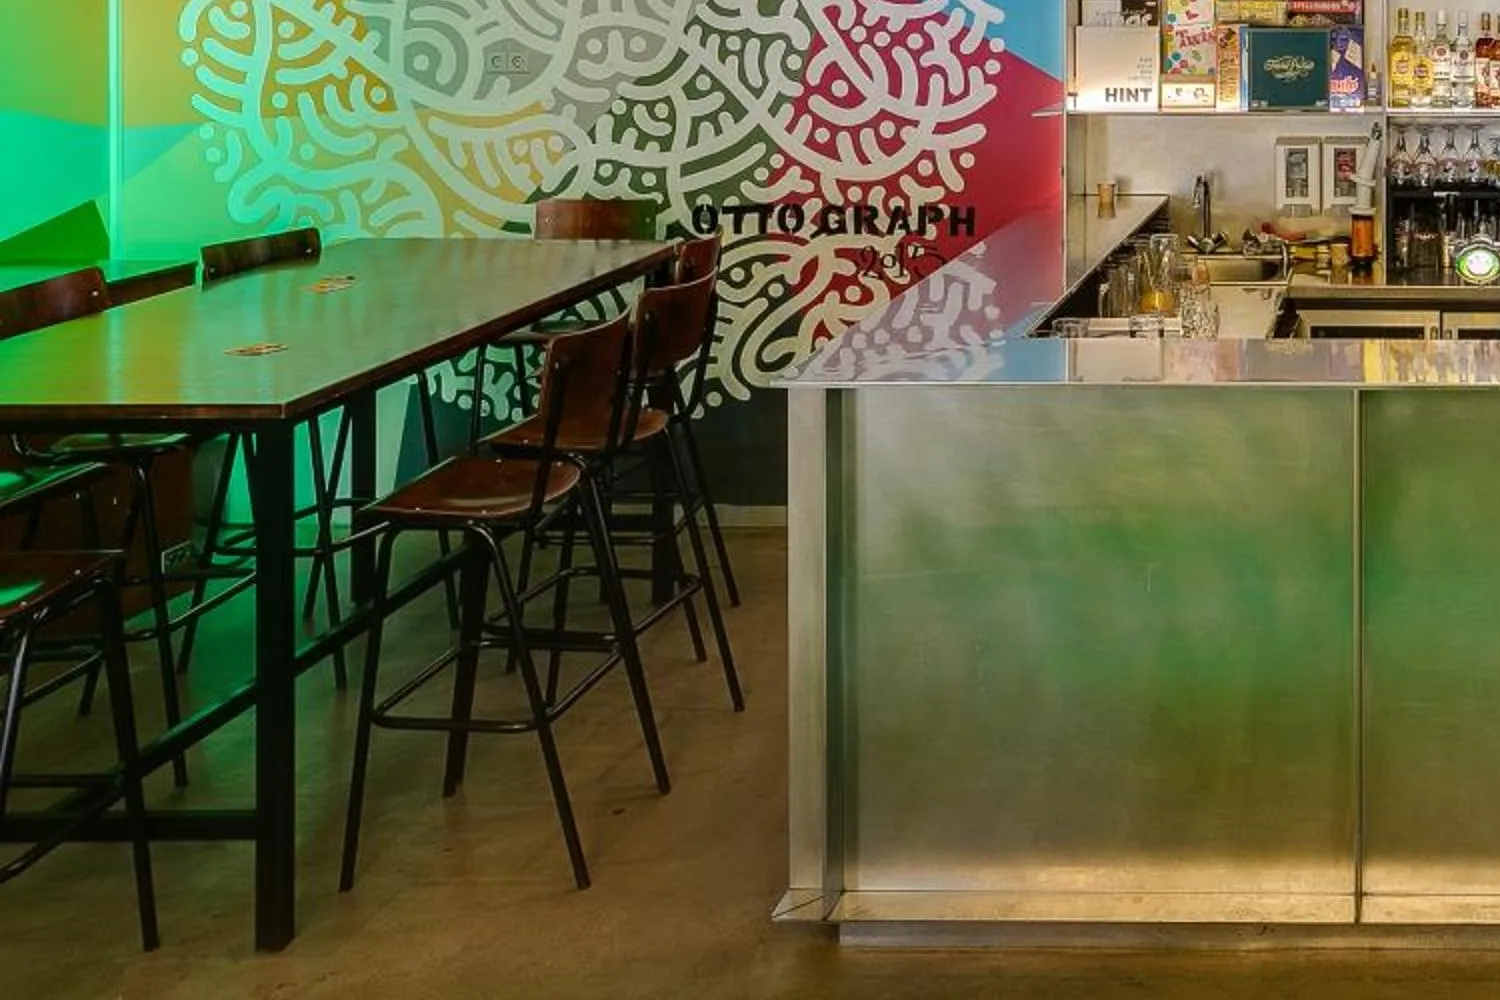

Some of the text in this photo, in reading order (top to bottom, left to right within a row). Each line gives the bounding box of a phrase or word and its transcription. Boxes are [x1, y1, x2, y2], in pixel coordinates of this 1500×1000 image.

[1105, 87, 1152, 103] HINT
[691, 203, 976, 238] OTTO GRAPH
